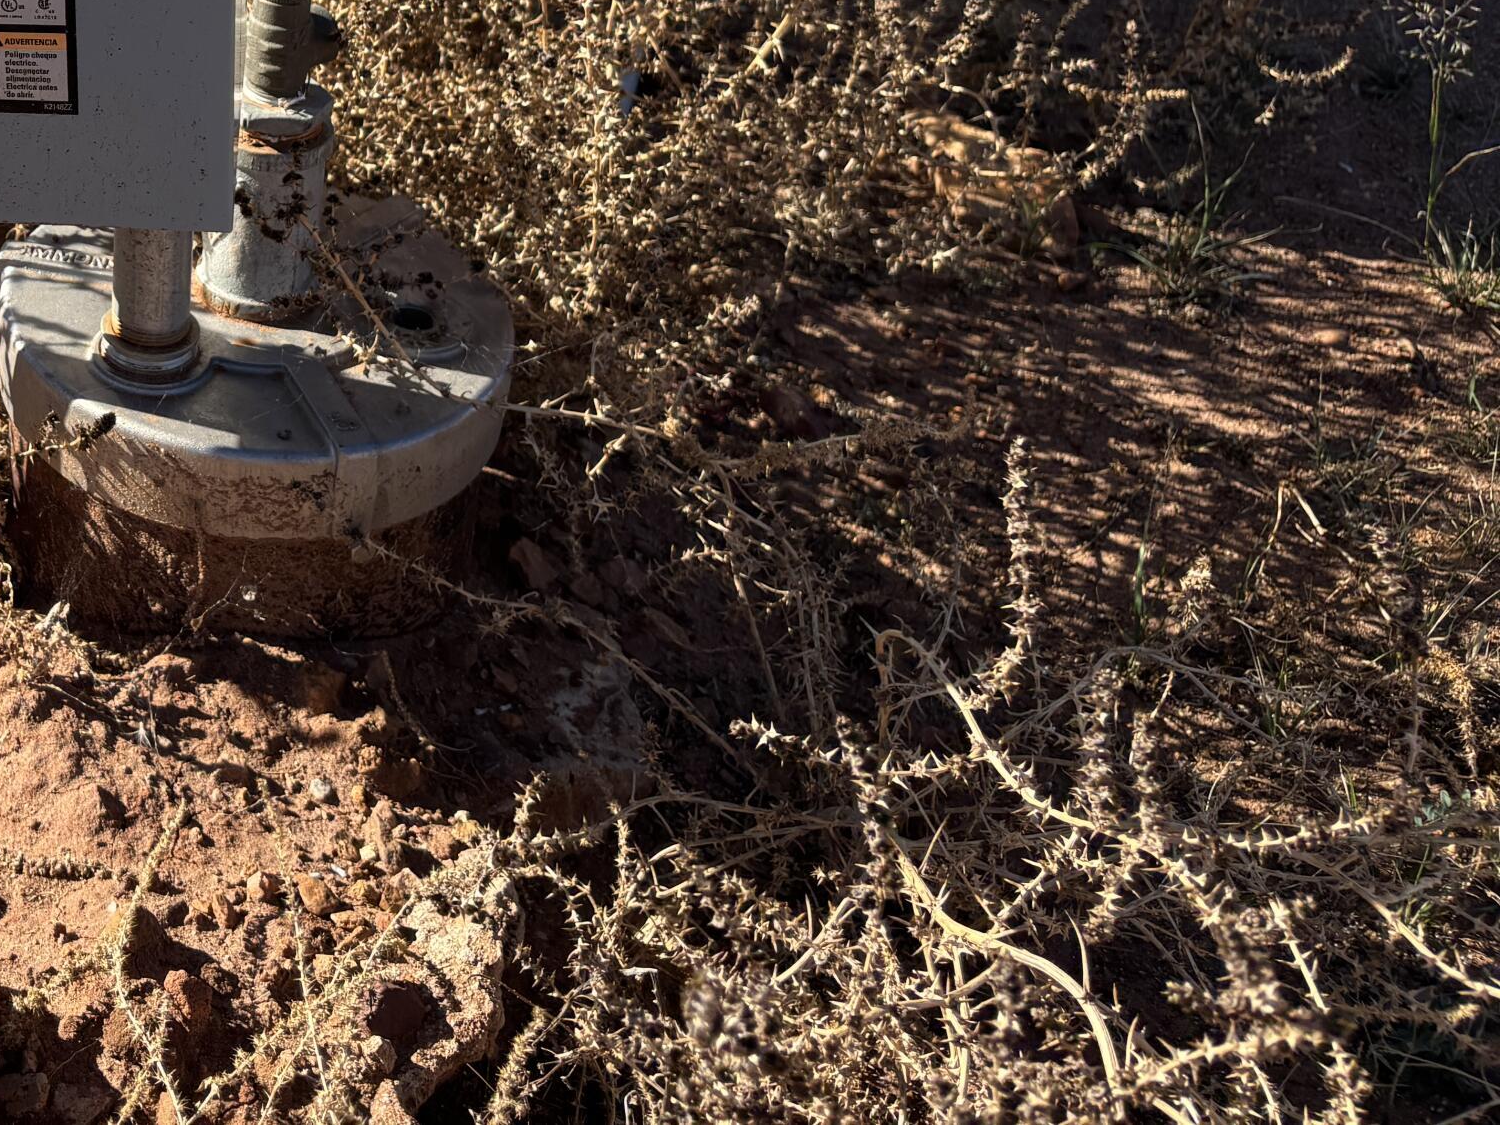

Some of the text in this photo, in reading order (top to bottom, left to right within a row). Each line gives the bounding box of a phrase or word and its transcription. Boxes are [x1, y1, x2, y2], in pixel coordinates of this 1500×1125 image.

[4, 38, 58, 47] ADVERTENCIA
[4, 51, 57, 61] Peligro choque
[18, 91, 35, 99] abrir.
